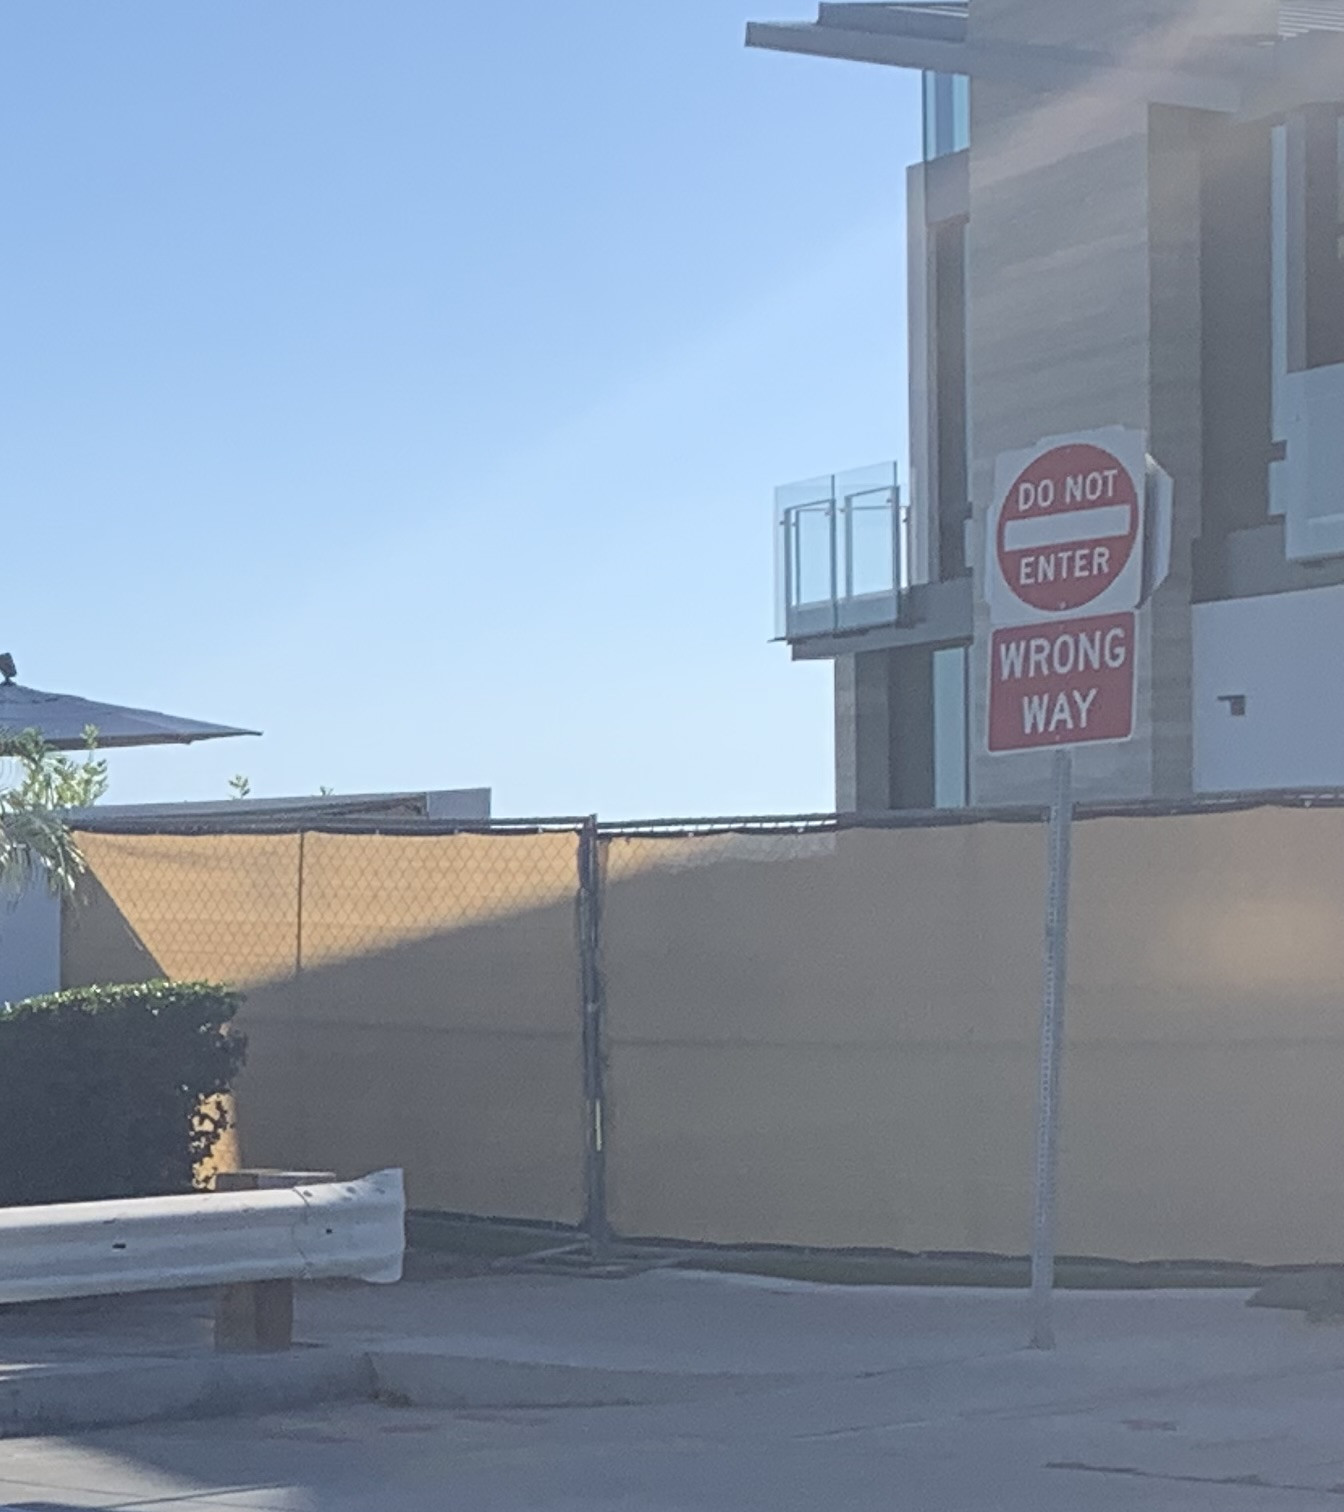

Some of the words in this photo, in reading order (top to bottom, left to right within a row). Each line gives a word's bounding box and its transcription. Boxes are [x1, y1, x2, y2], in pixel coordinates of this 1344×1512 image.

[1018, 479, 1054, 511] DO
[1065, 469, 1118, 504] NOT
[1019, 547, 1110, 585] ENTER
[1000, 627, 1126, 681] WRONG
[1022, 688, 1099, 734] WAY
